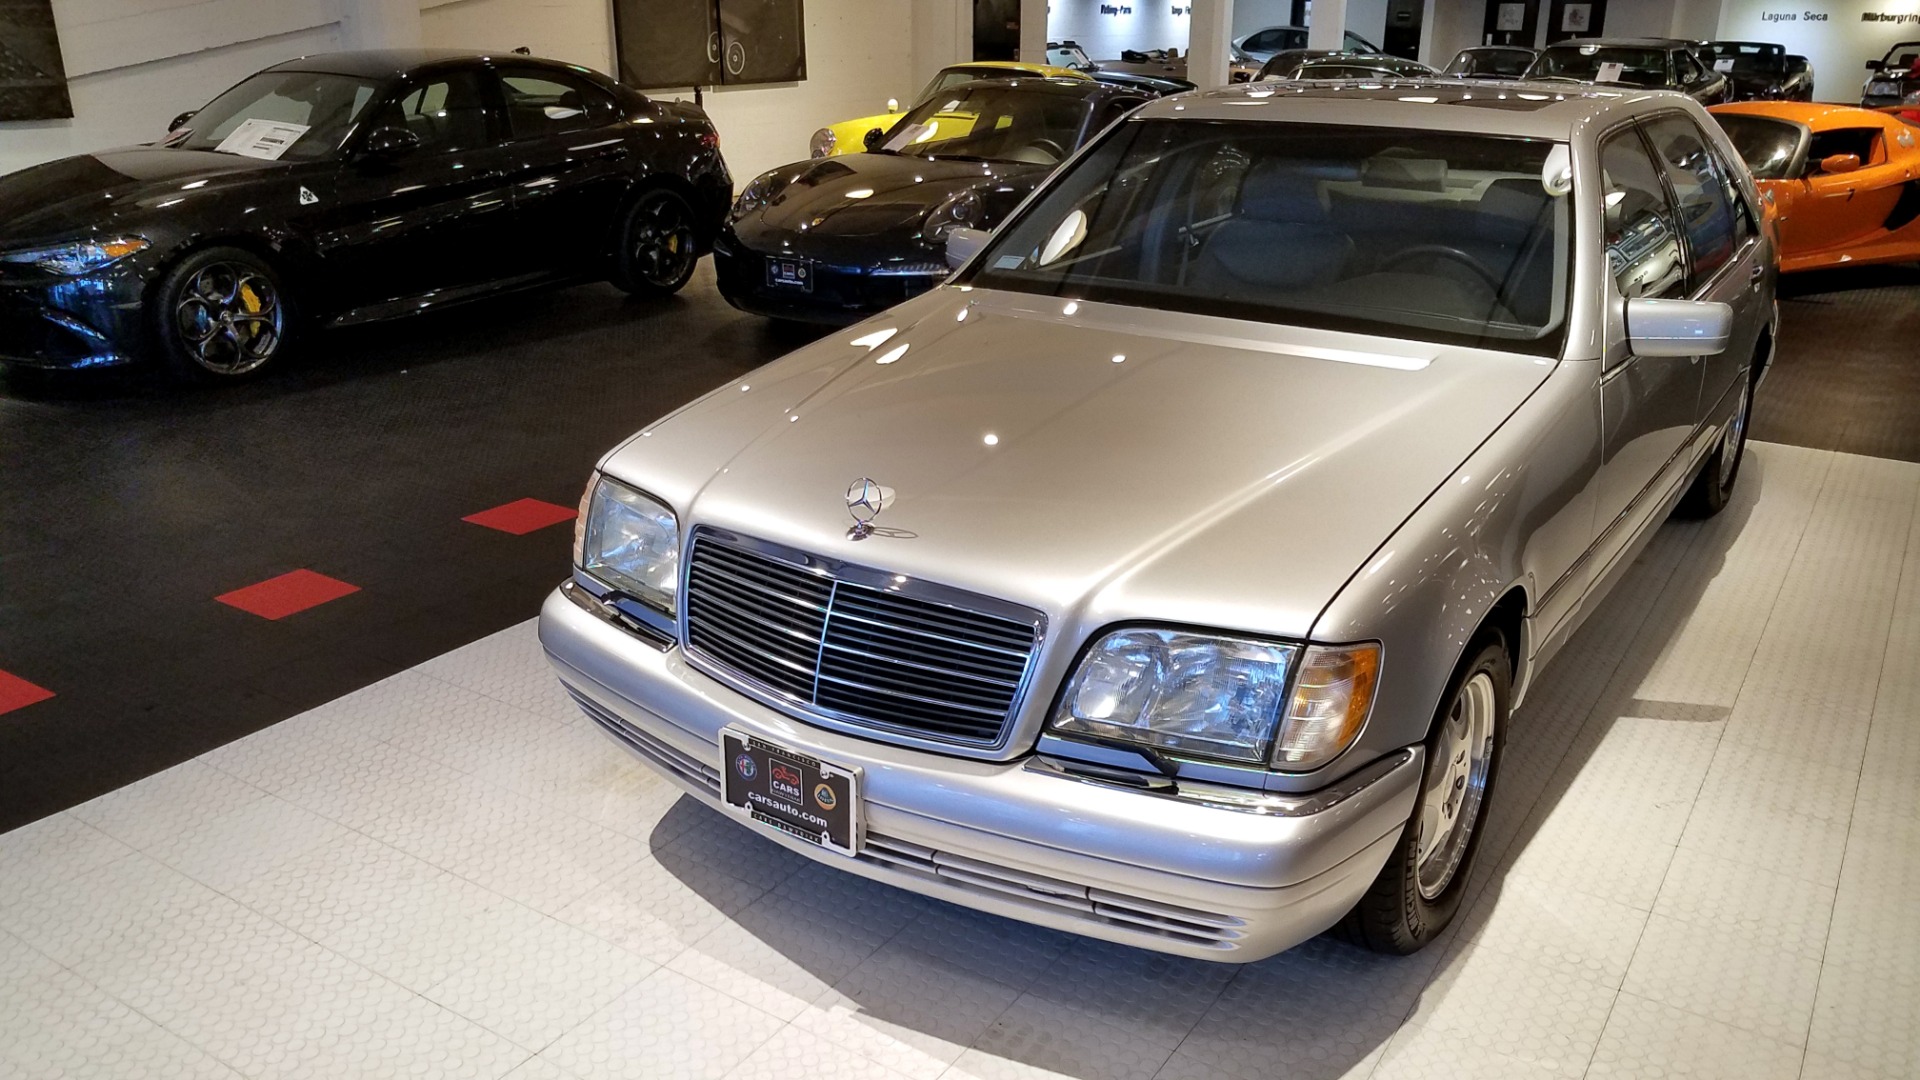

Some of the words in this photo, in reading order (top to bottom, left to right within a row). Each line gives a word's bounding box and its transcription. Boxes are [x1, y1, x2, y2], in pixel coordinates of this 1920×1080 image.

[1762, 11, 1797, 22] Laguna
[1803, 11, 1828, 21] Seca
[771, 747, 817, 767] FRANCISCO
[773, 780, 800, 797] CARS
[747, 791, 828, 828] carsauto.com
[1405, 841, 1420, 931] MICHELIN
